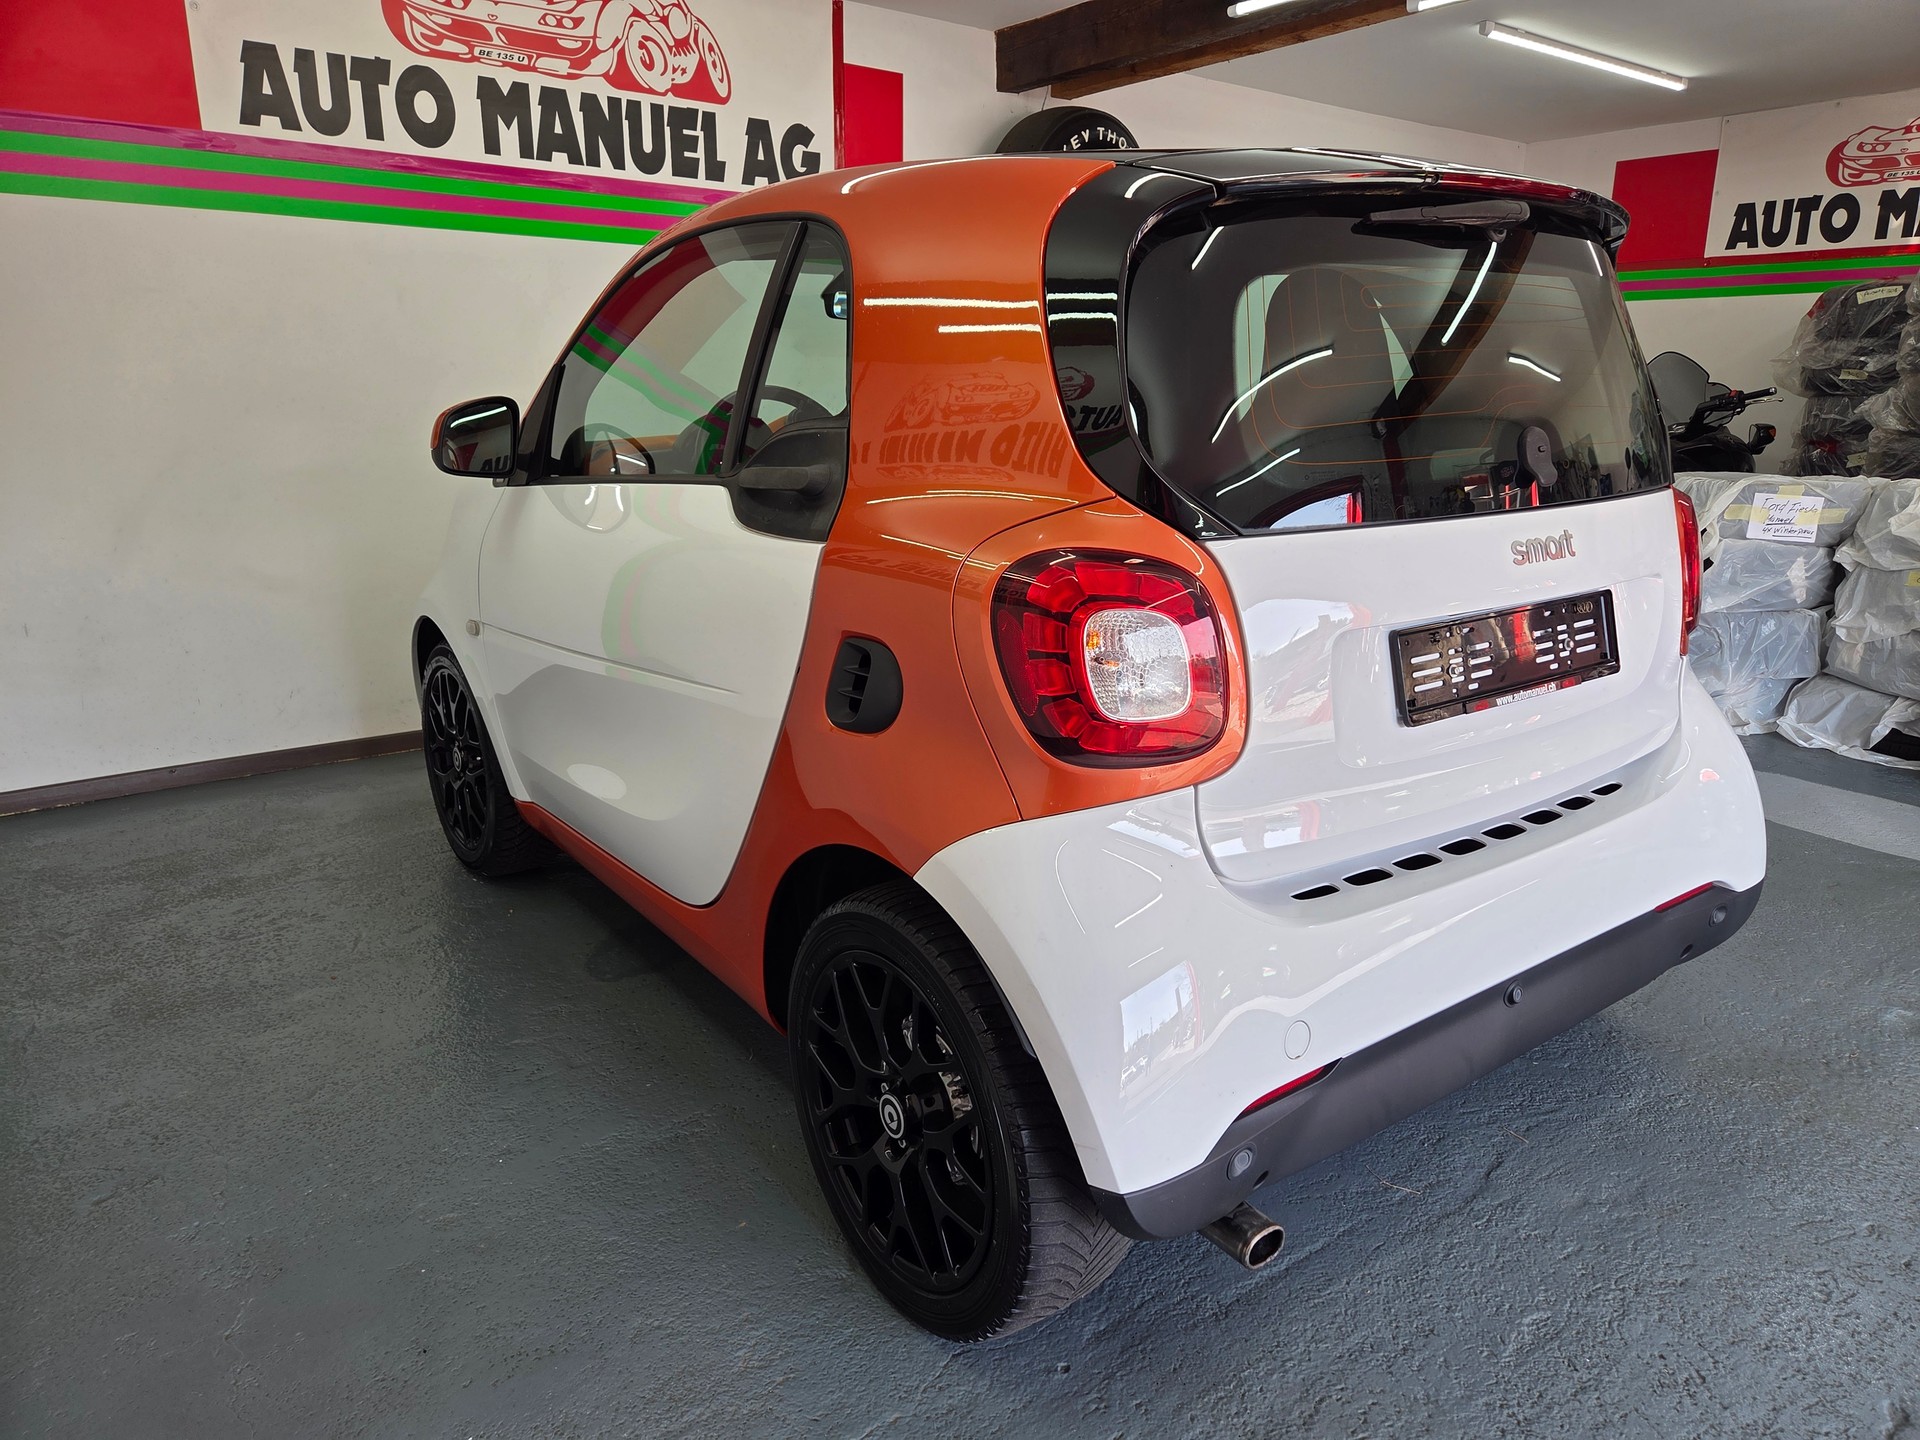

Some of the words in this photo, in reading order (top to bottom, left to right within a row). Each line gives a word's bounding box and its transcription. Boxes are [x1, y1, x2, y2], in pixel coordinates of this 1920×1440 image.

[478, 49, 494, 58] BE
[496, 52, 515, 61] 135
[517, 55, 526, 63] U
[239, 39, 456, 149] AUTO
[476, 75, 727, 183] MANUEL
[741, 116, 821, 186] AG
[1096, 126, 1133, 150] THO
[1725, 192, 1861, 251] AUTO
[1873, 186, 1920, 241] M
[1760, 497, 1790, 515] Ford
[1510, 529, 1576, 566] smart
[1495, 681, 1557, 706] www.automanuel.ch
